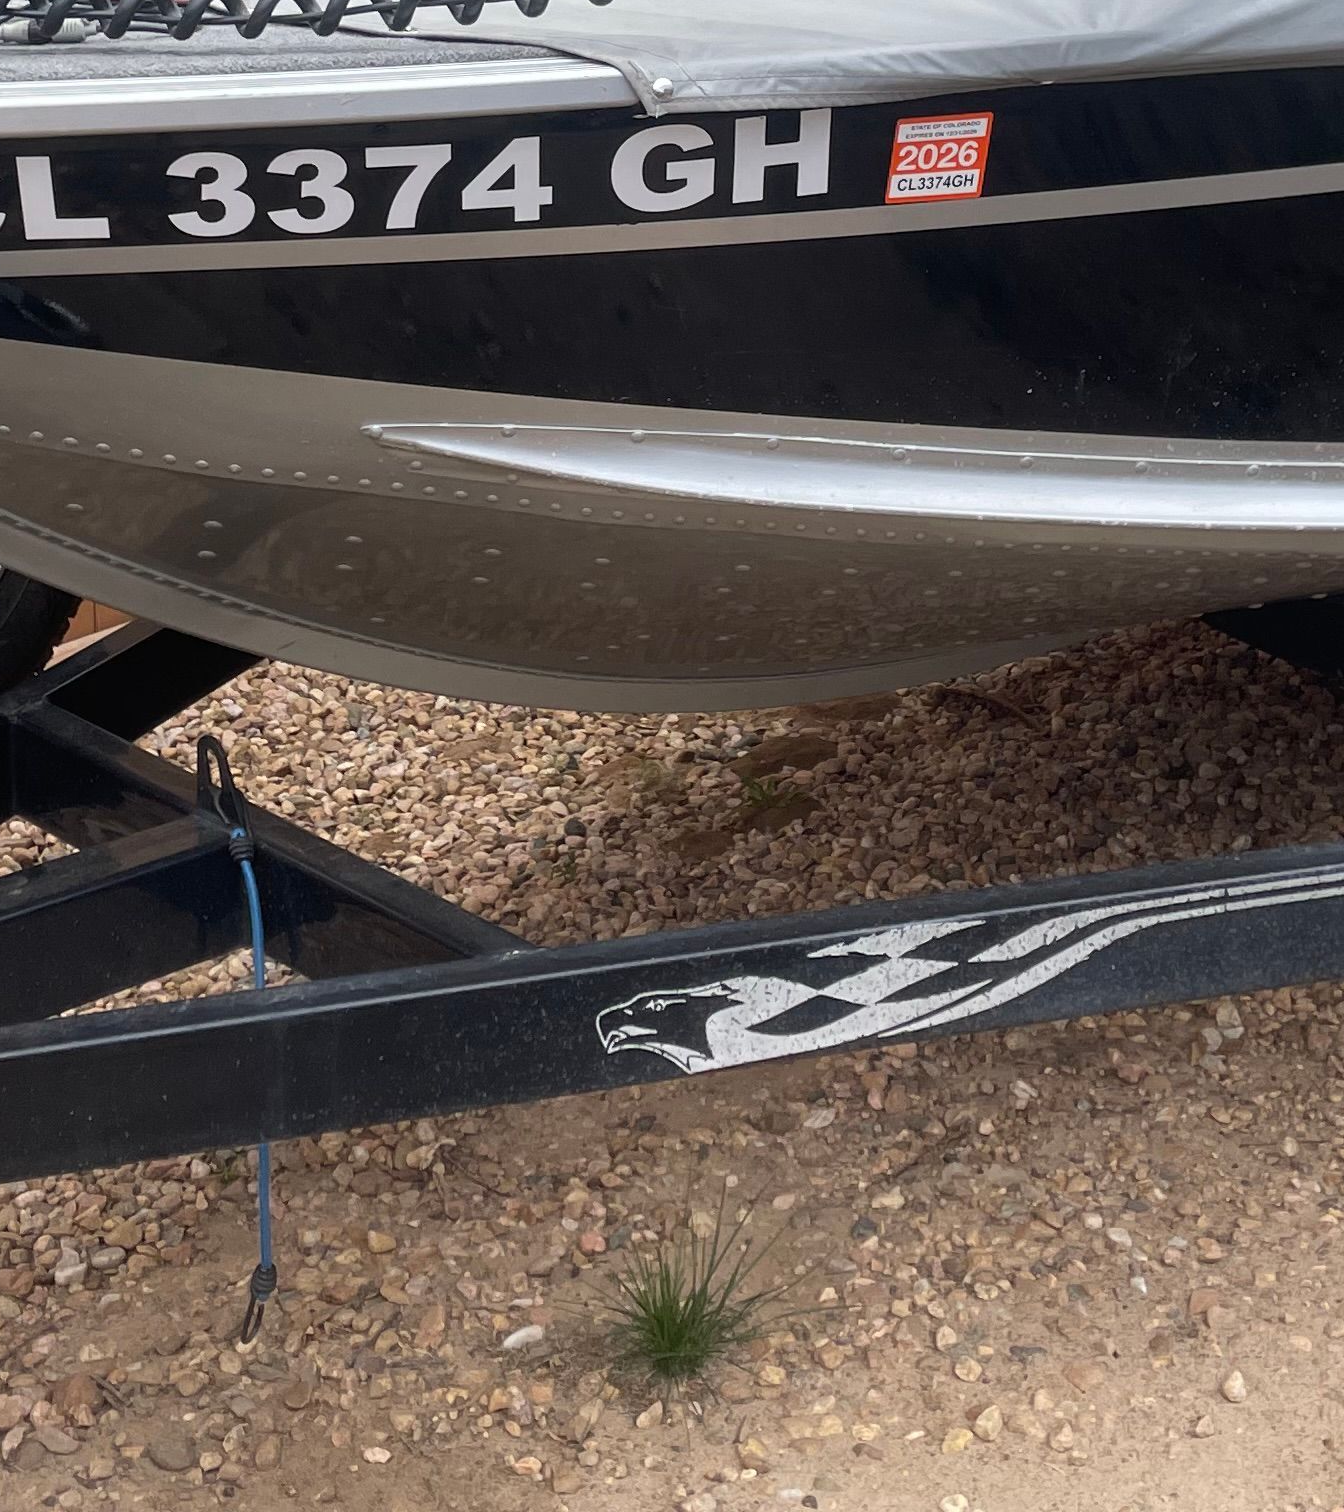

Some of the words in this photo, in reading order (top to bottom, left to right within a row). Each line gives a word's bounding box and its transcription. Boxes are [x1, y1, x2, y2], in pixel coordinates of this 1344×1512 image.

[896, 140, 979, 171] 2026
[166, 135, 554, 240] 3374
[609, 107, 830, 213] GH
[897, 174, 975, 191] CL3374GH
